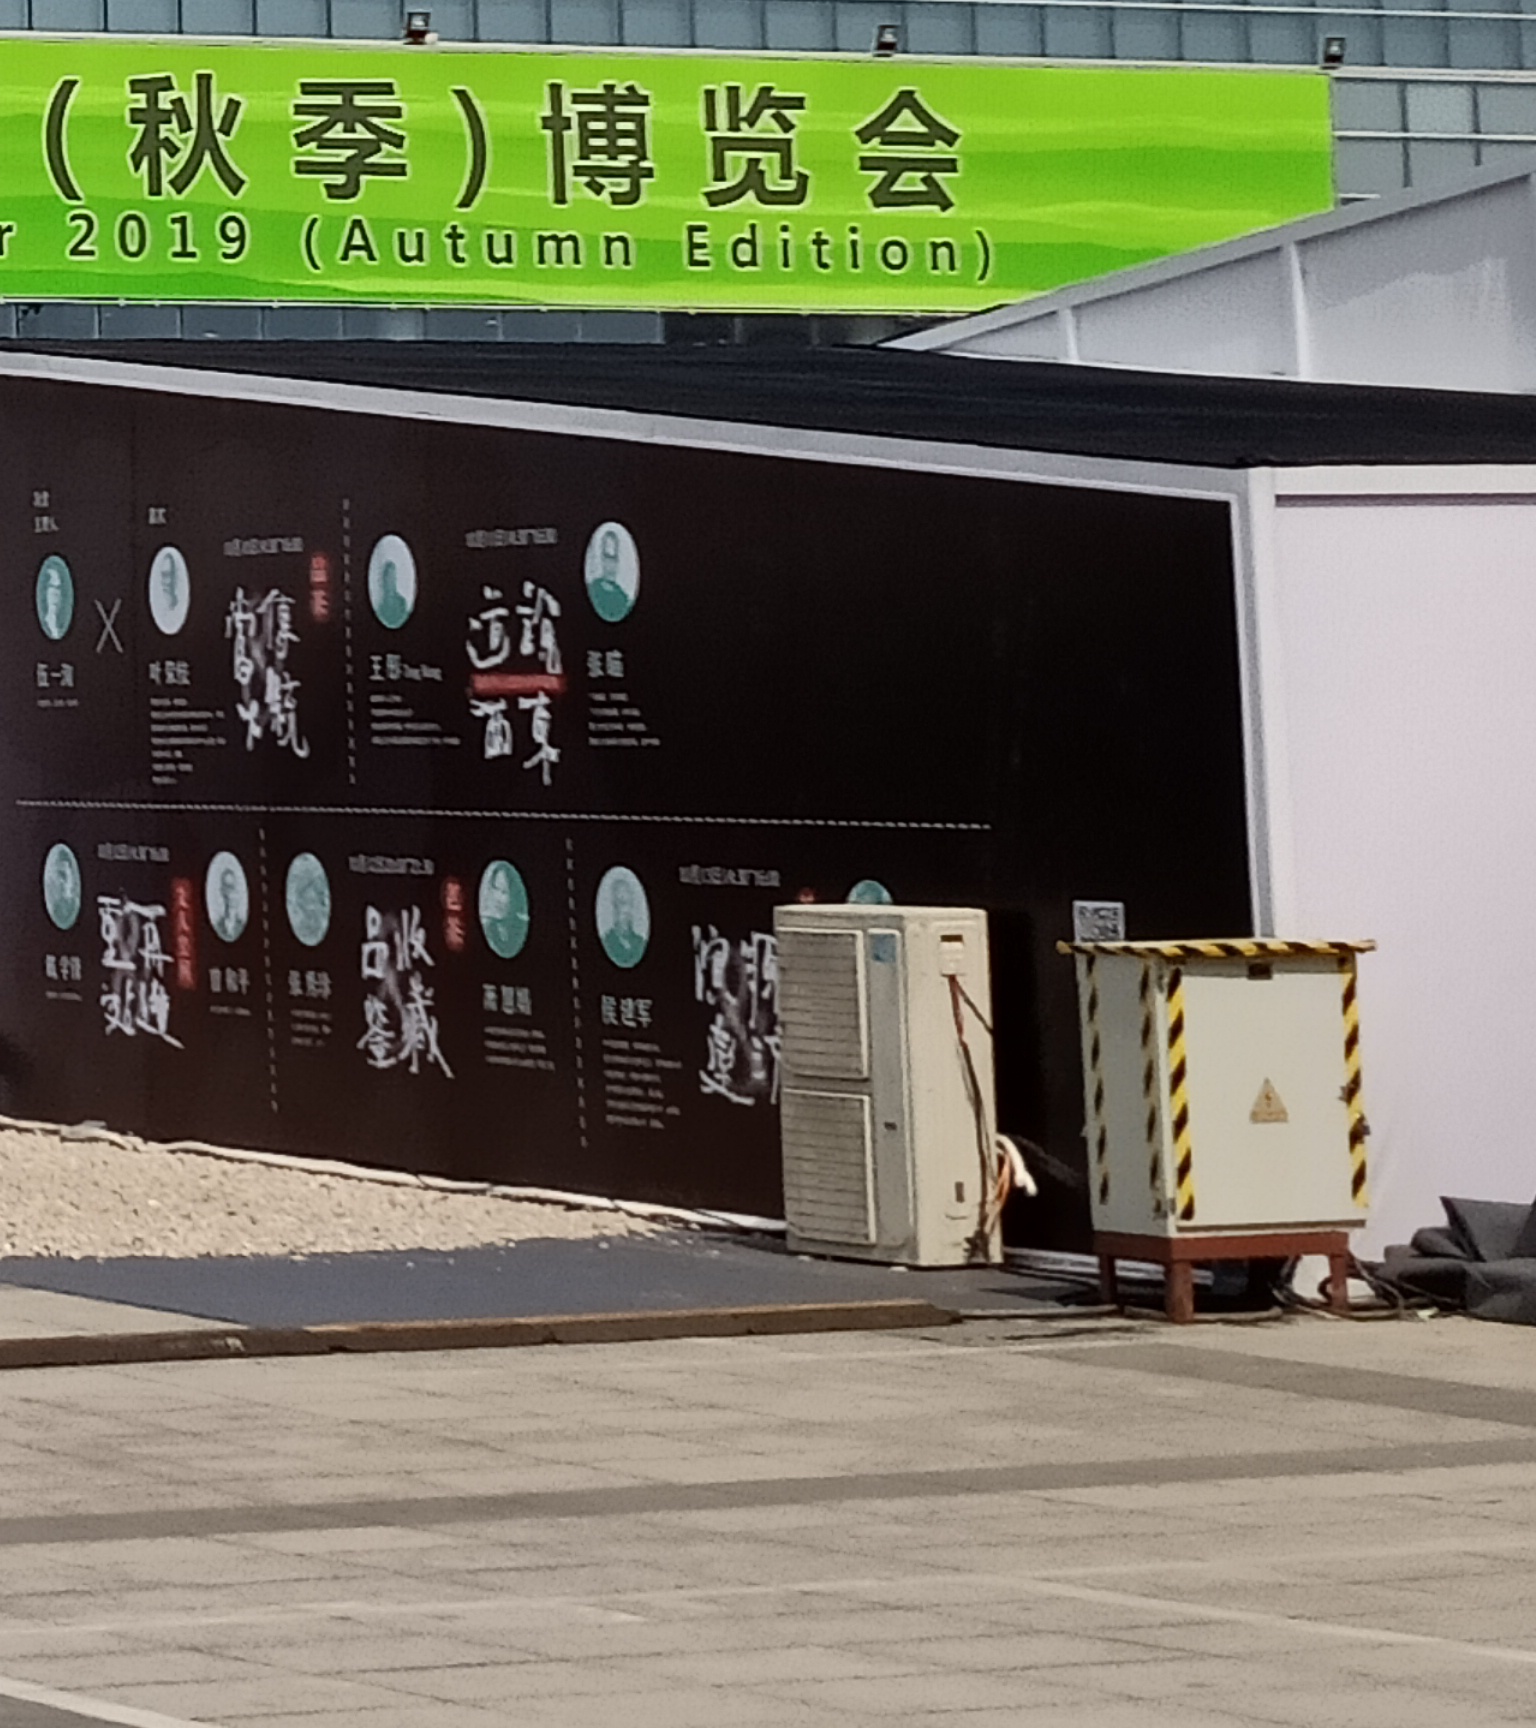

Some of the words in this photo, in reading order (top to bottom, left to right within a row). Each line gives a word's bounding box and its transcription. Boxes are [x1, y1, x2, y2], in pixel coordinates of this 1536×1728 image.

[68, 212, 247, 261] 2019
[304, 216, 632, 269] (Autumn
[686, 222, 991, 282] Edition)
